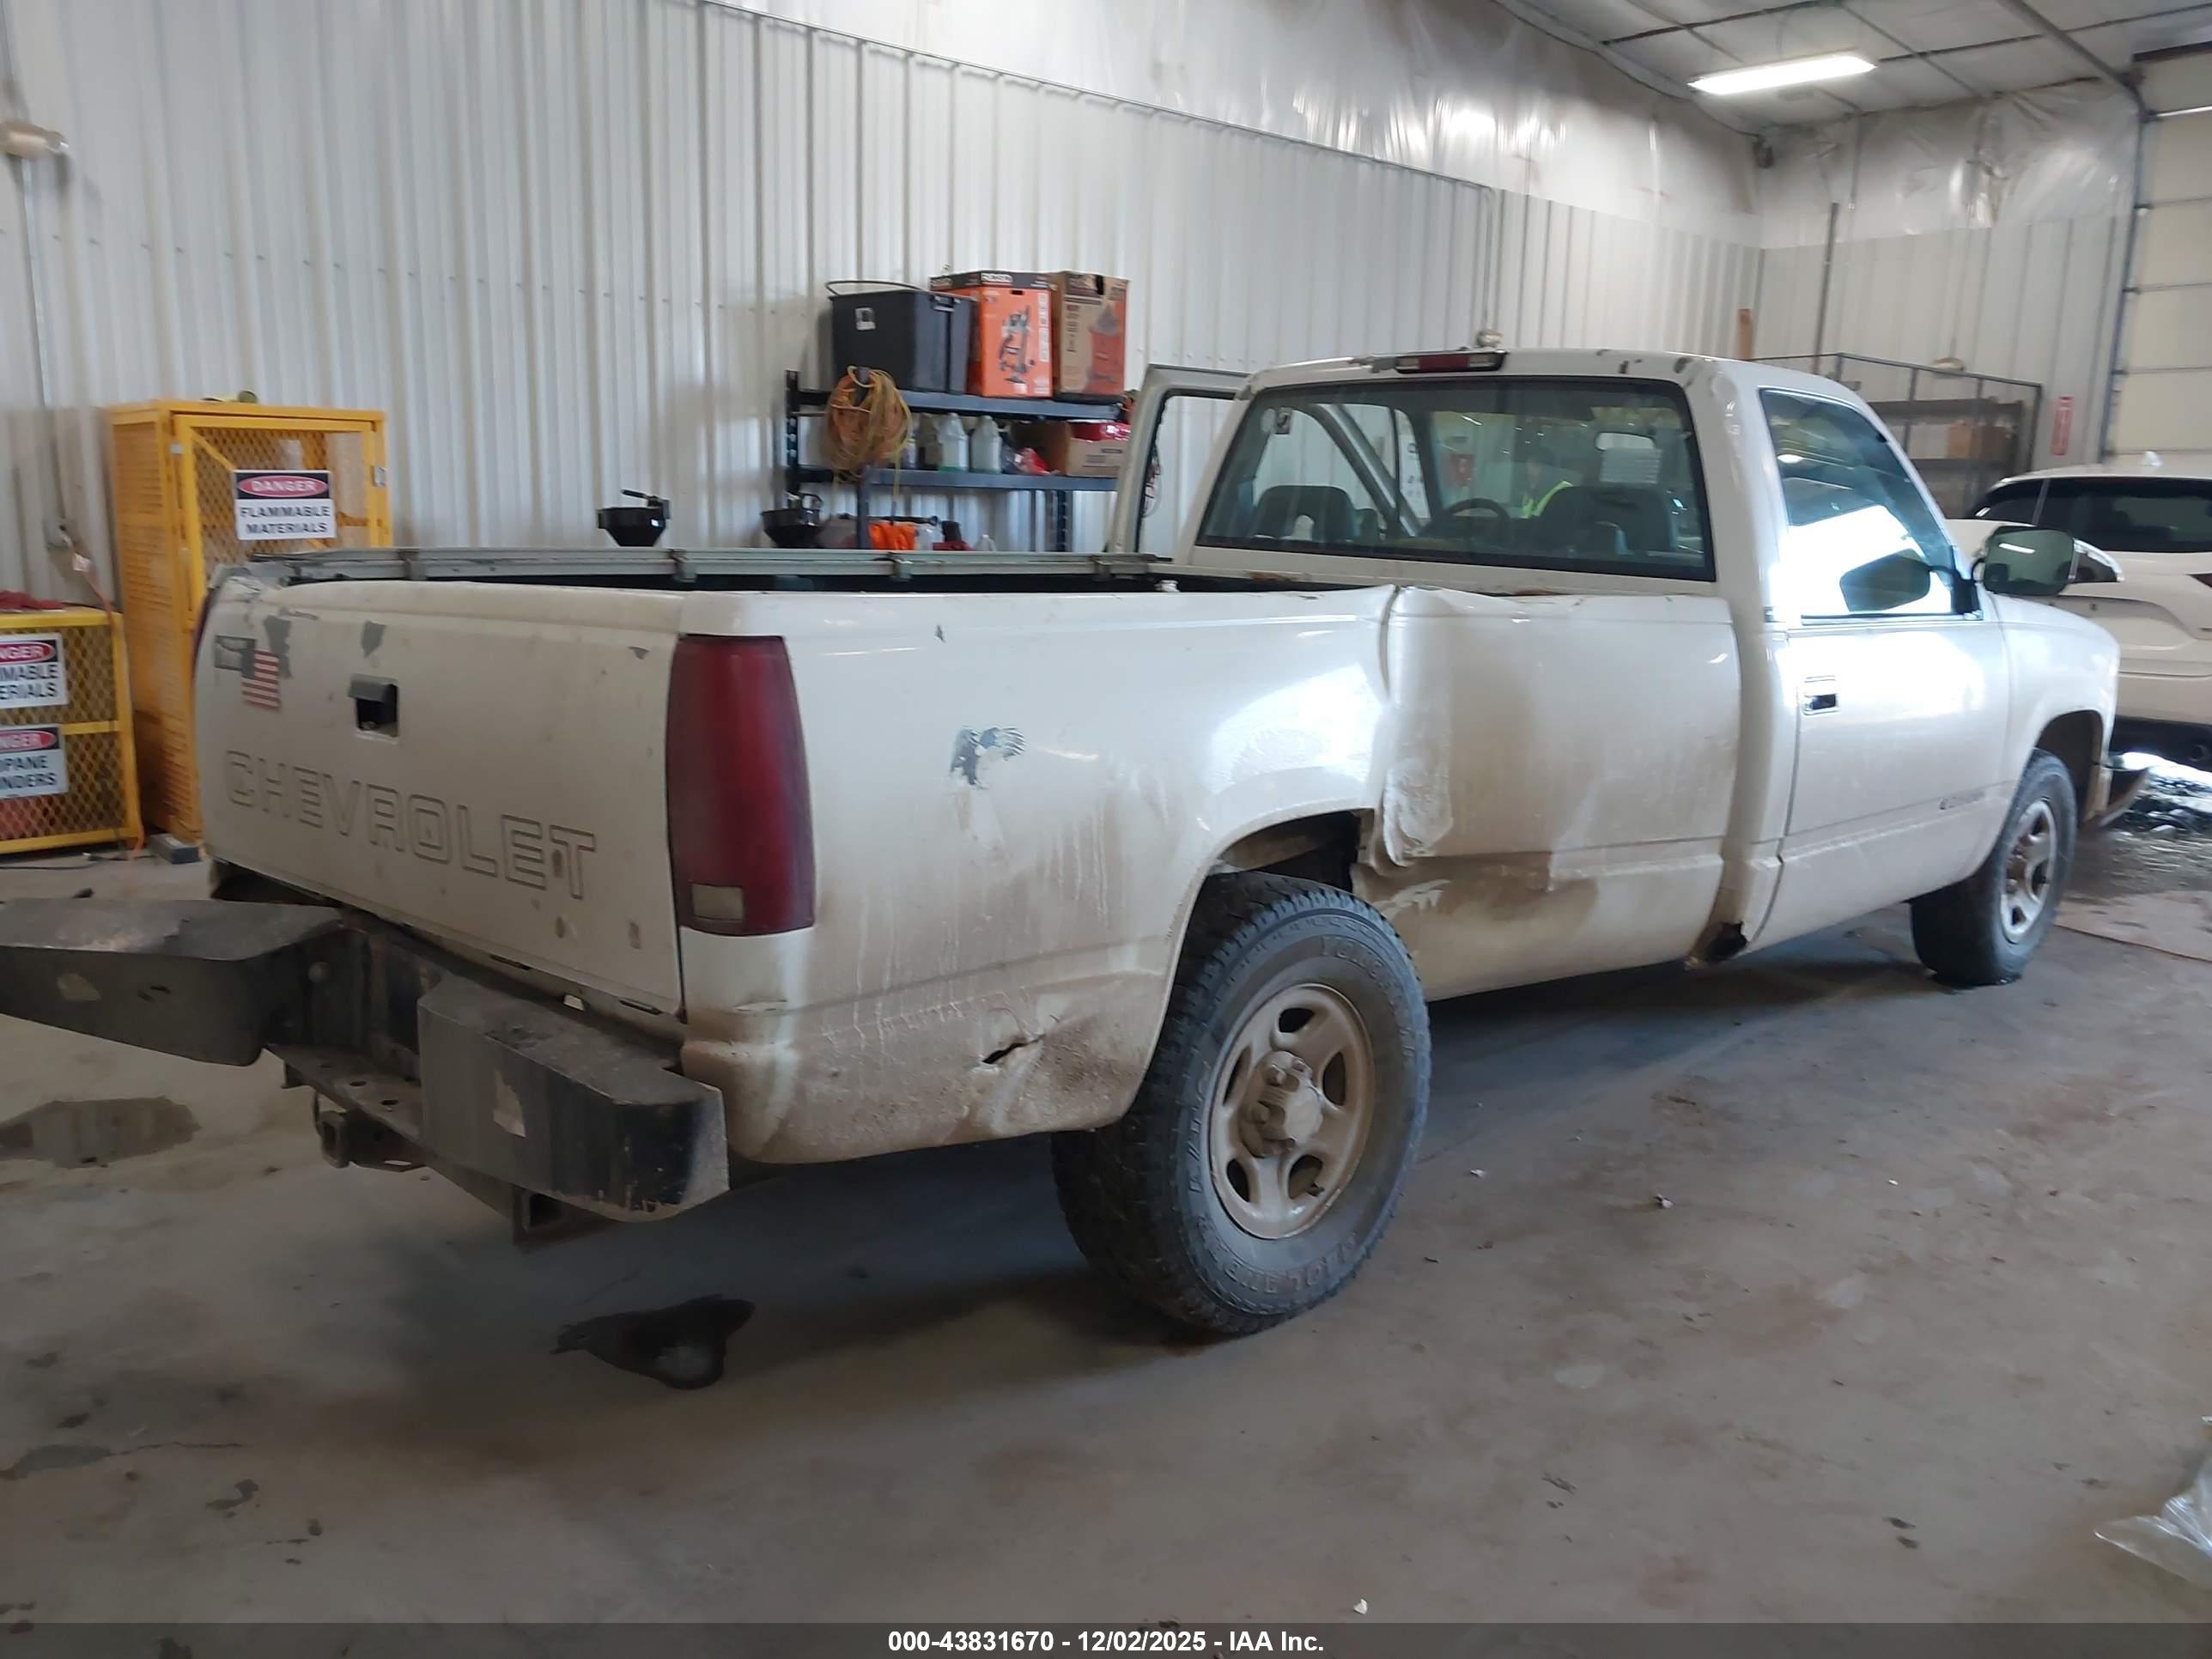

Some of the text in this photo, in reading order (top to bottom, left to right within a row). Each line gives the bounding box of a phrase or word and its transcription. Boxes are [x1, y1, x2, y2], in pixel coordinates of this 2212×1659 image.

[251, 479, 317, 493] DANGER
[240, 505, 331, 517] FLAMMABLE
[246, 521, 328, 534] MATERIALS
[226, 750, 597, 901] CHEVROLET
